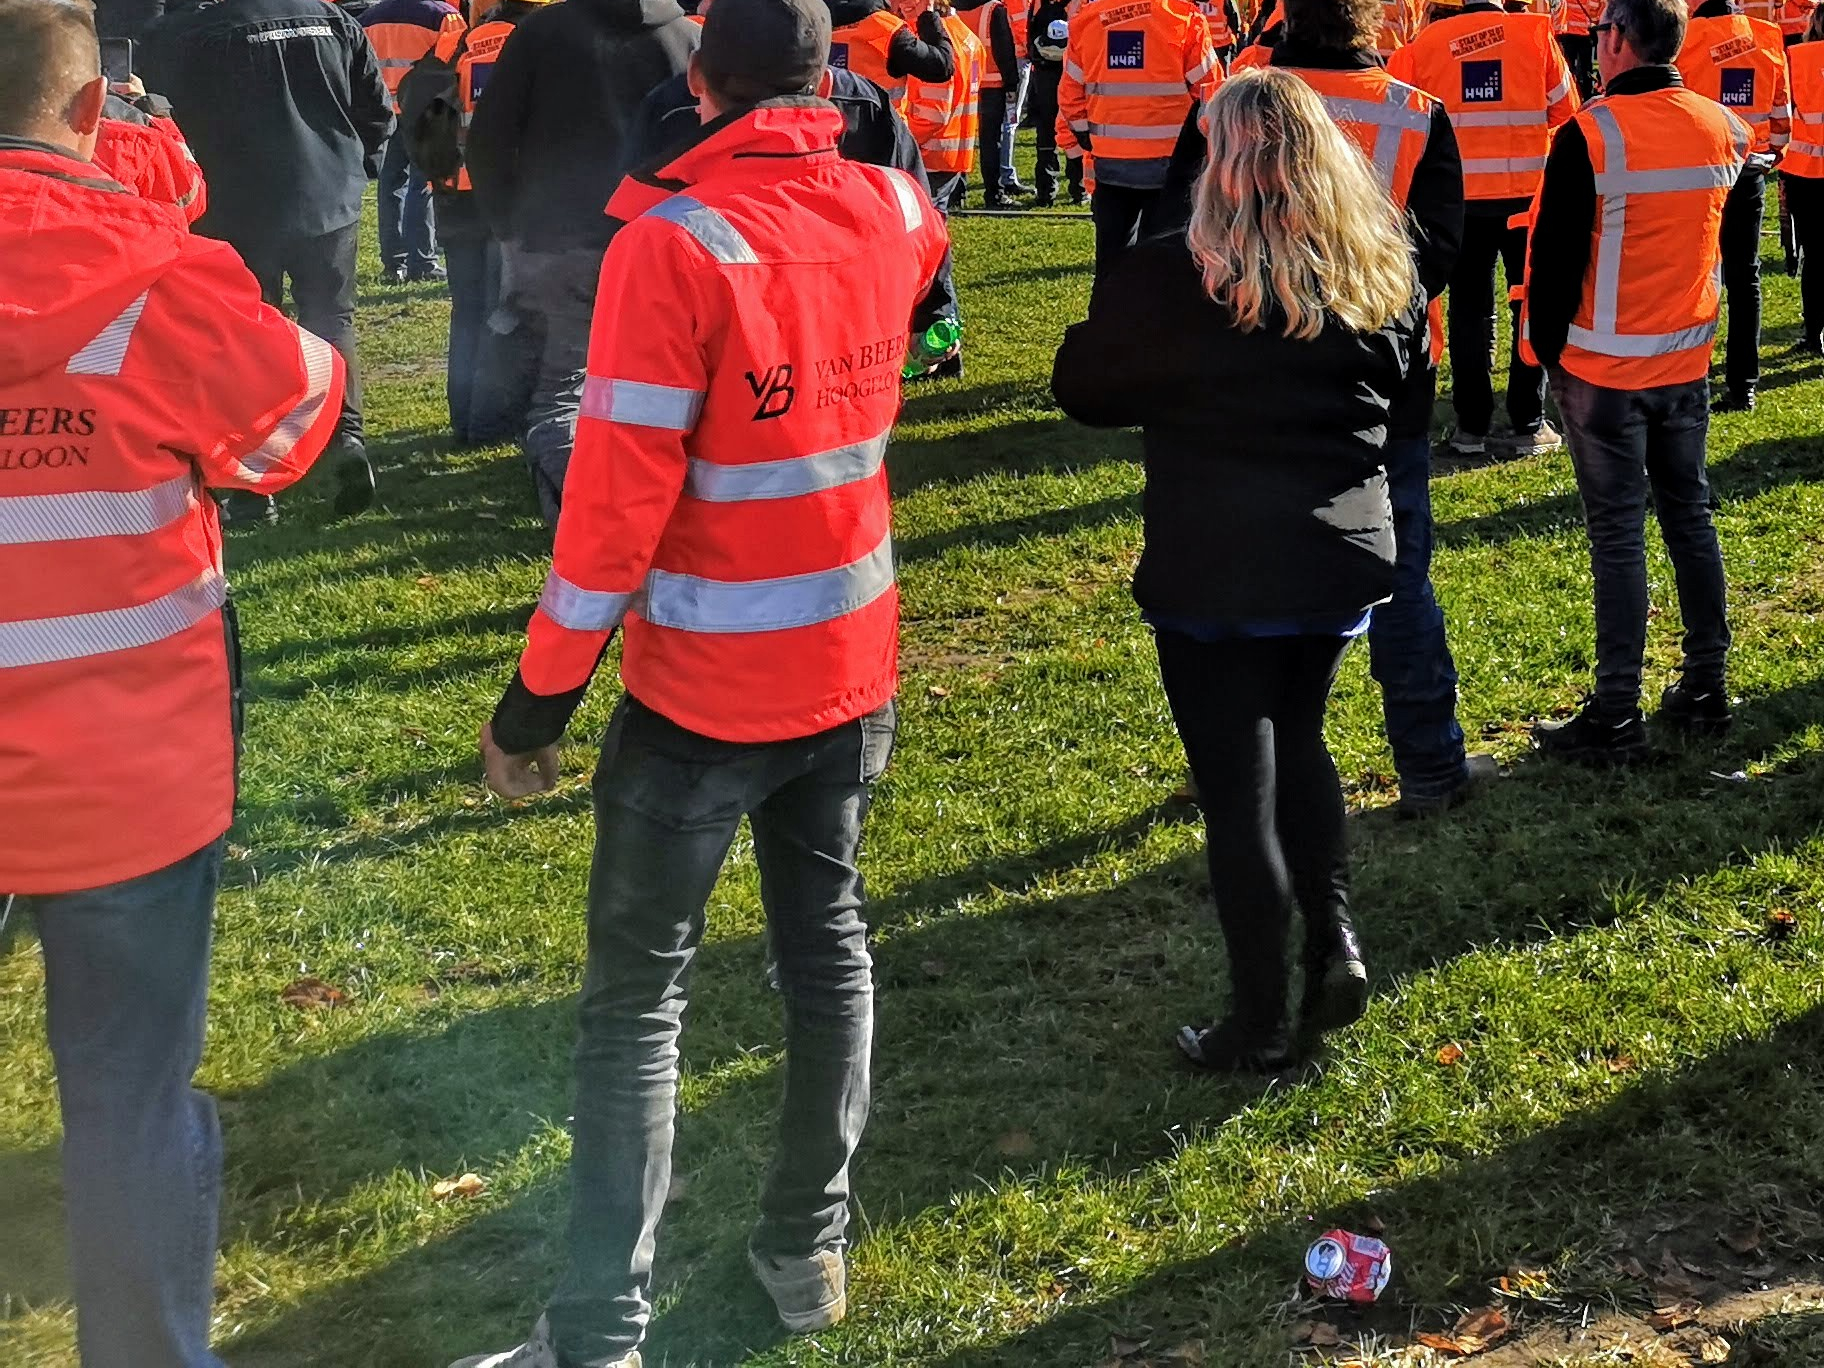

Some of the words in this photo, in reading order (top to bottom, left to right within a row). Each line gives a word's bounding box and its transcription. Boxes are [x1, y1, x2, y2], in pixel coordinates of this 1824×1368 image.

[1465, 87, 1494, 99] H4A
[815, 353, 854, 381] VAN
[0, 407, 96, 436] EERS
[0, 445, 90, 470] LOON
